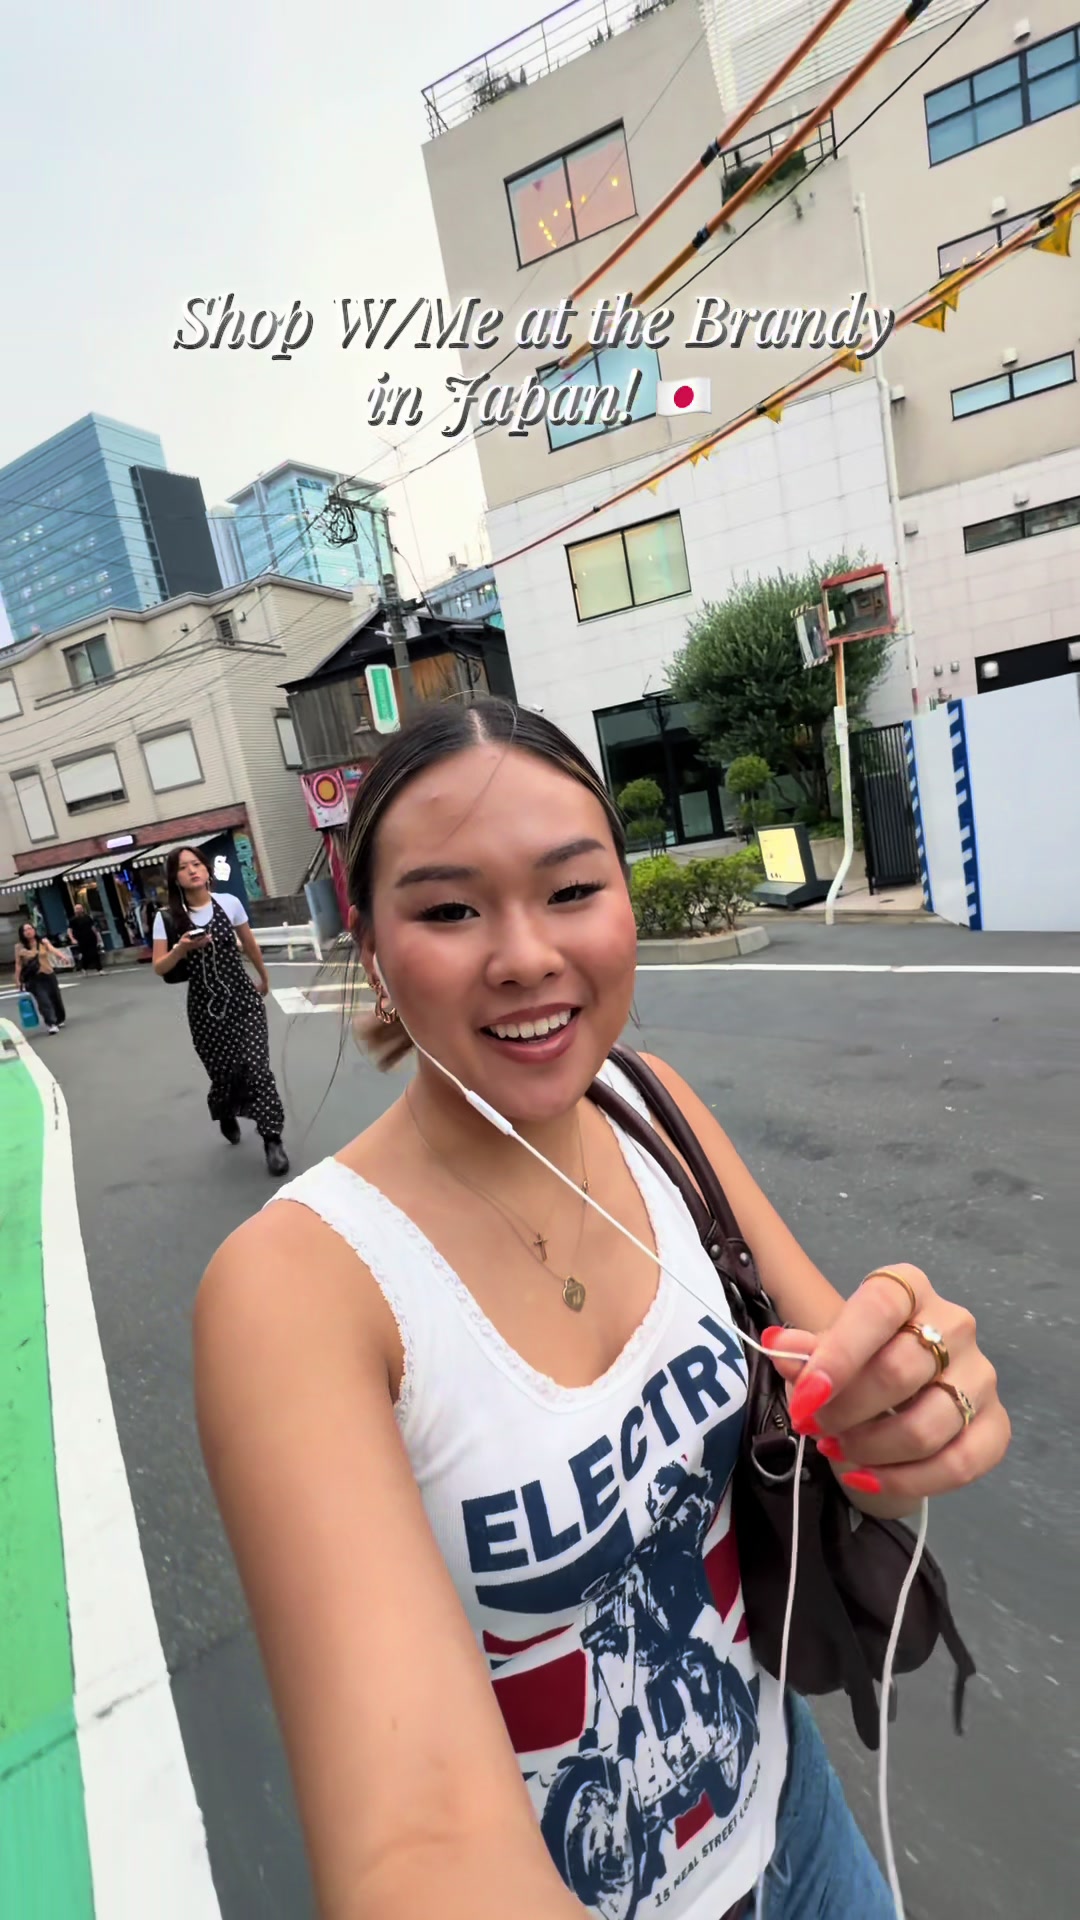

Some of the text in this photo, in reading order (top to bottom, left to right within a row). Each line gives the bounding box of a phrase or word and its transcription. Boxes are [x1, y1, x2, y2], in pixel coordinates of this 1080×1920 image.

[654, 1887, 671, 1908] 15
[673, 1856, 700, 1891] NEAL
[701, 1815, 738, 1859] STREET
